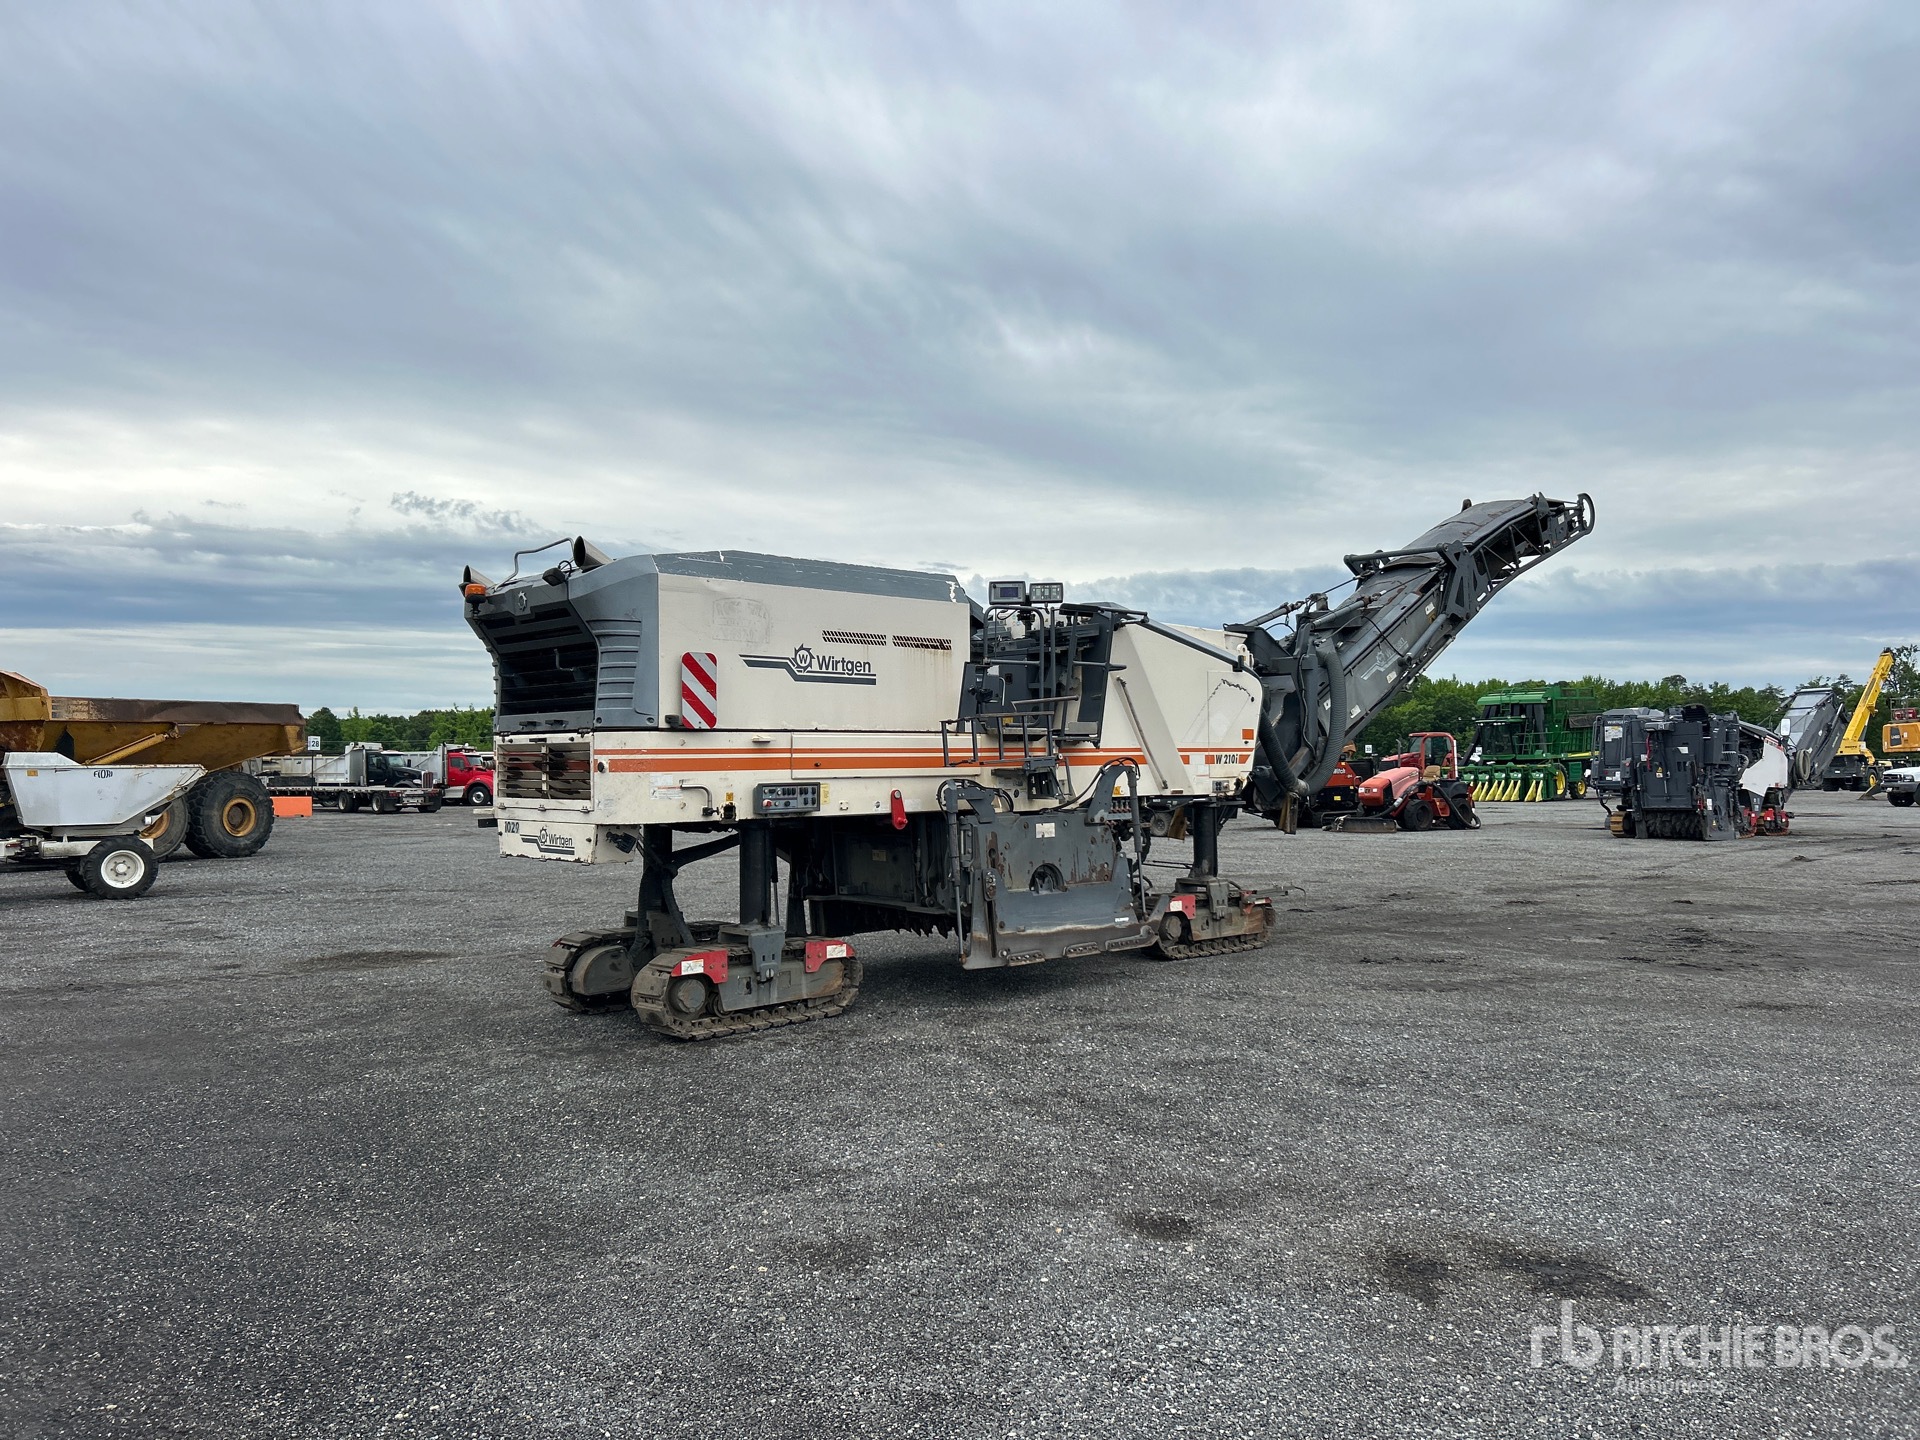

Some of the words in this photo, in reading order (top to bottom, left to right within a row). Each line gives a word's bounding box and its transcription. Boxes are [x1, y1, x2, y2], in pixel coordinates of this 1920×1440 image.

[816, 654, 871, 676] Wirtgen
[1215, 754, 1223, 764] W
[1223, 753, 1238, 765] 210i
[504, 821, 520, 833] 1029
[548, 833, 573, 848] Wirtgen
